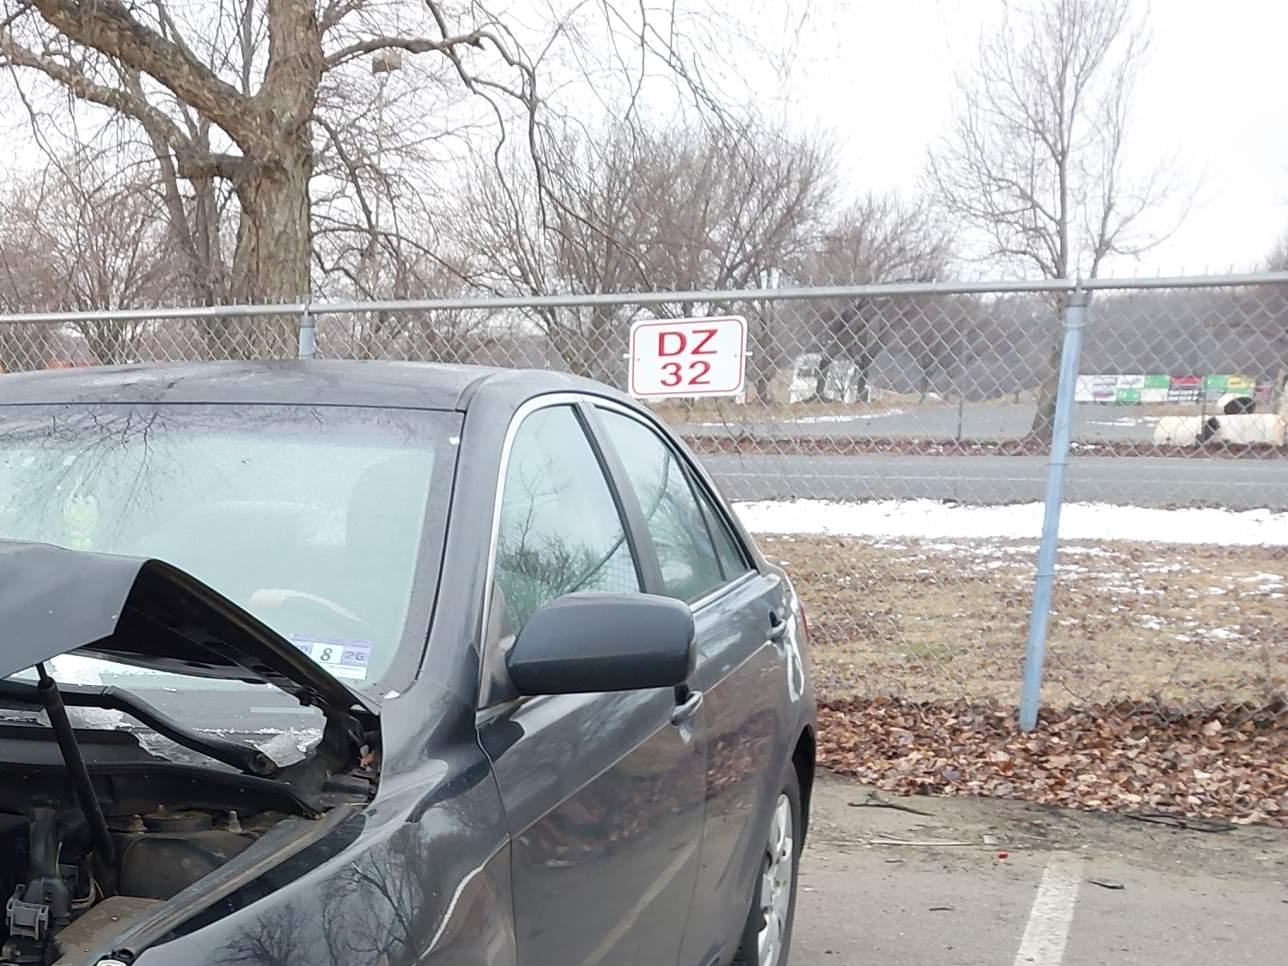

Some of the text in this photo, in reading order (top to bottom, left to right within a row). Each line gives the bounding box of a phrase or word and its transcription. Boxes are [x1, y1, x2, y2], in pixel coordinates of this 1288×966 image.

[658, 328, 718, 357] DZ
[660, 360, 711, 387] 32
[320, 647, 333, 662] 8
